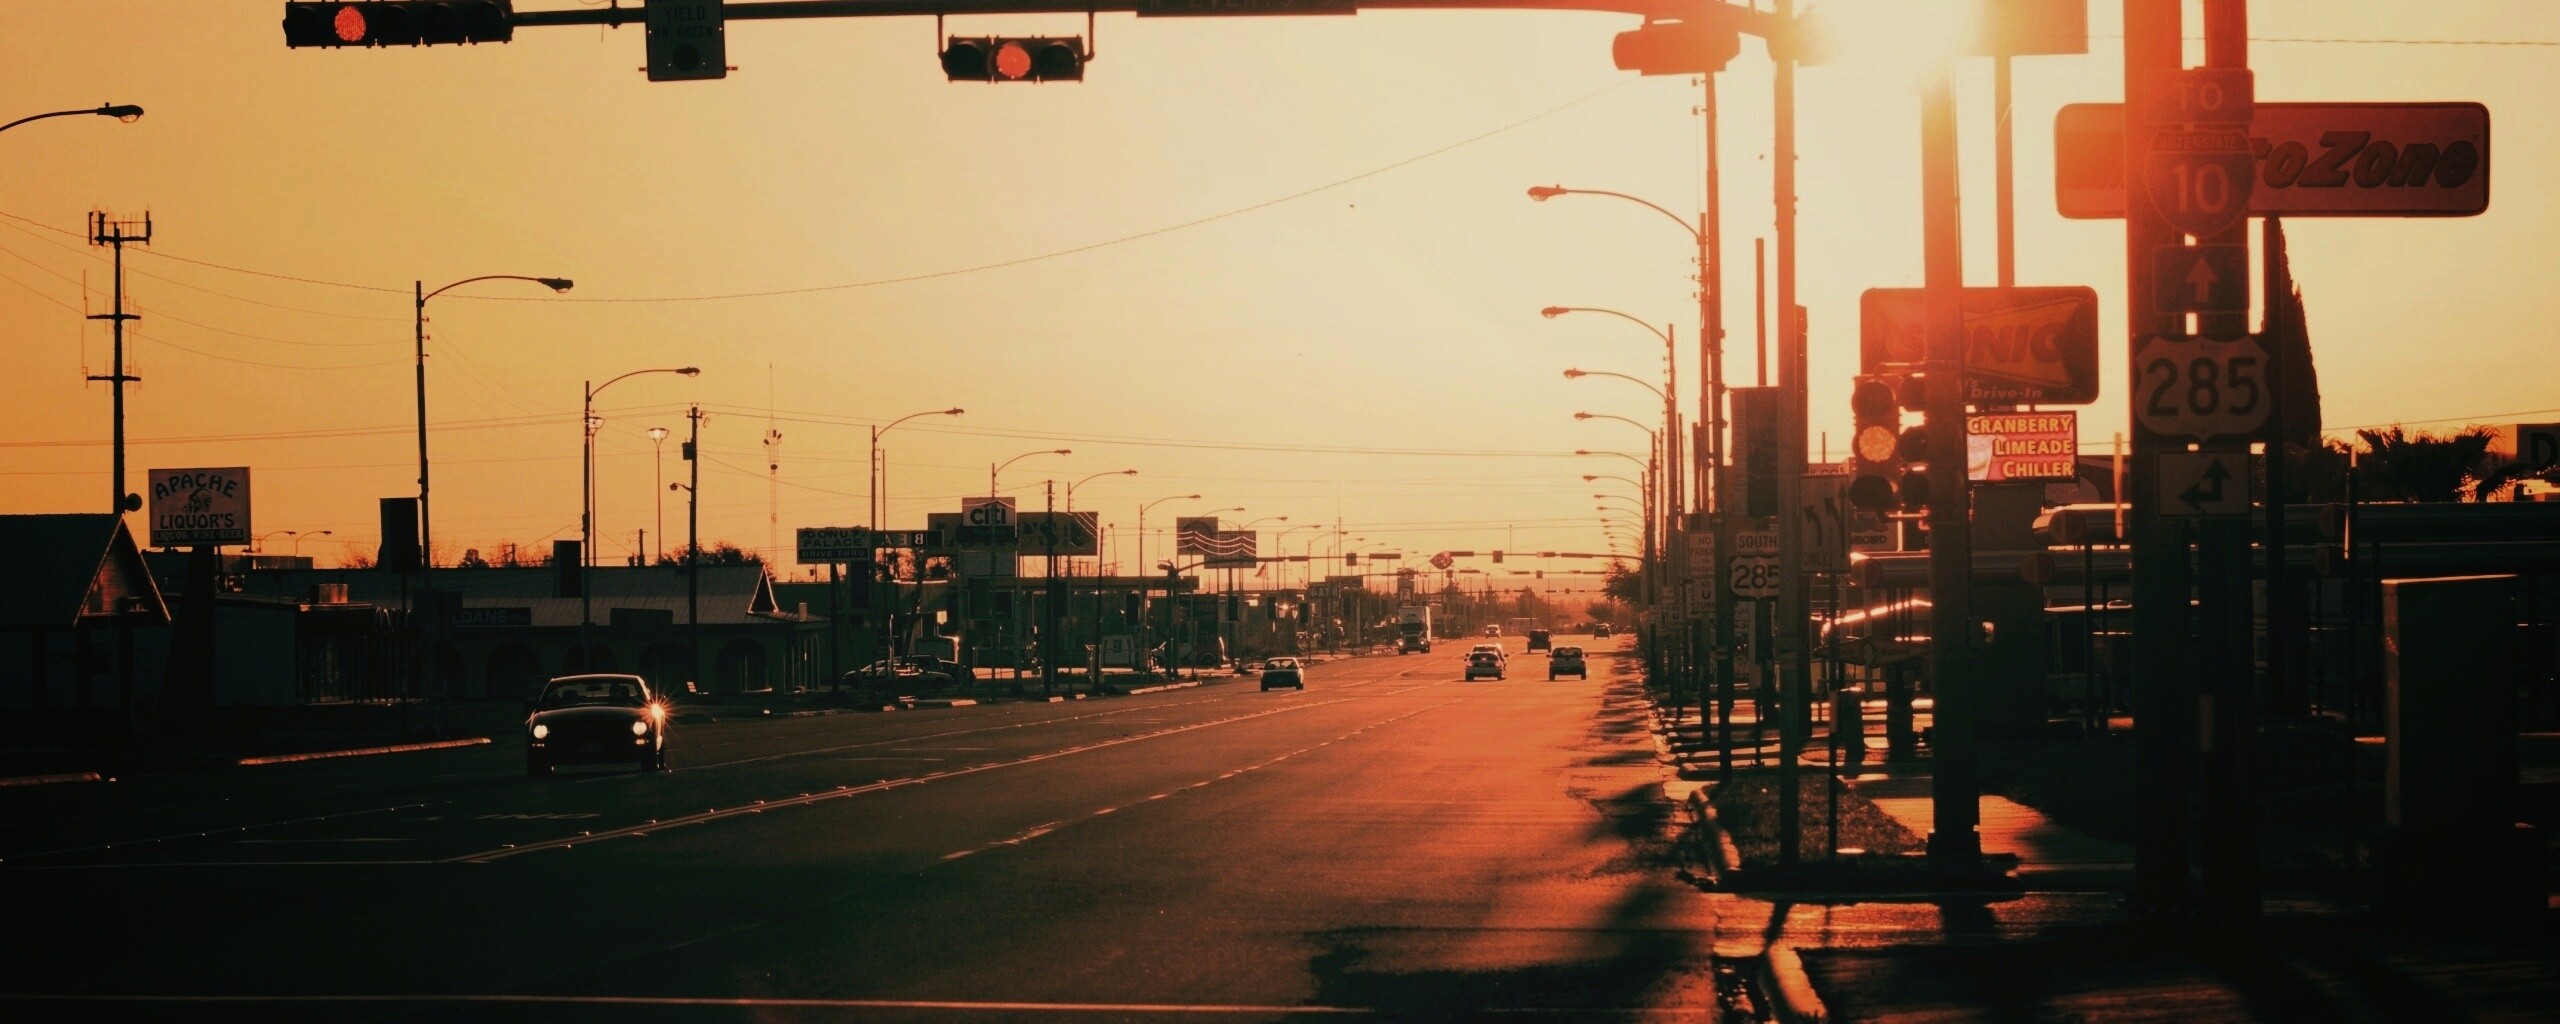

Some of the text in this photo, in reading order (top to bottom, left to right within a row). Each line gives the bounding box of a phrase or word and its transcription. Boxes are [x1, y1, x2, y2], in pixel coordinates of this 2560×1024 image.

[664, 6, 706, 22] YIELD
[653, 25, 714, 40] ON GREEN
[2173, 82, 2224, 111] TO
[2173, 163, 2230, 214] 10
[1886, 322, 2066, 365] SNIC
[2146, 356, 2259, 417] 285
[1966, 415, 2072, 435] CRANBERRY
[1993, 437, 2073, 457] LIMEADE
[2003, 458, 2073, 479] CHILLER
[156, 473, 238, 500] APACHE
[160, 513, 235, 529] LIQUOR'S
[970, 501, 1006, 526] citi
[802, 530, 862, 540] DONUT
[803, 538, 863, 548] PALACE
[1698, 536, 1712, 545] NO
[1737, 535, 1777, 549] SOUTH
[802, 549, 866, 558] DRIVE THRU
[1689, 547, 1716, 556] PARKIN
[1802, 551, 1830, 566] ONLY
[1700, 580, 1712, 589] NO
[1733, 564, 1779, 590] 285
[1701, 589, 1712, 600] U
